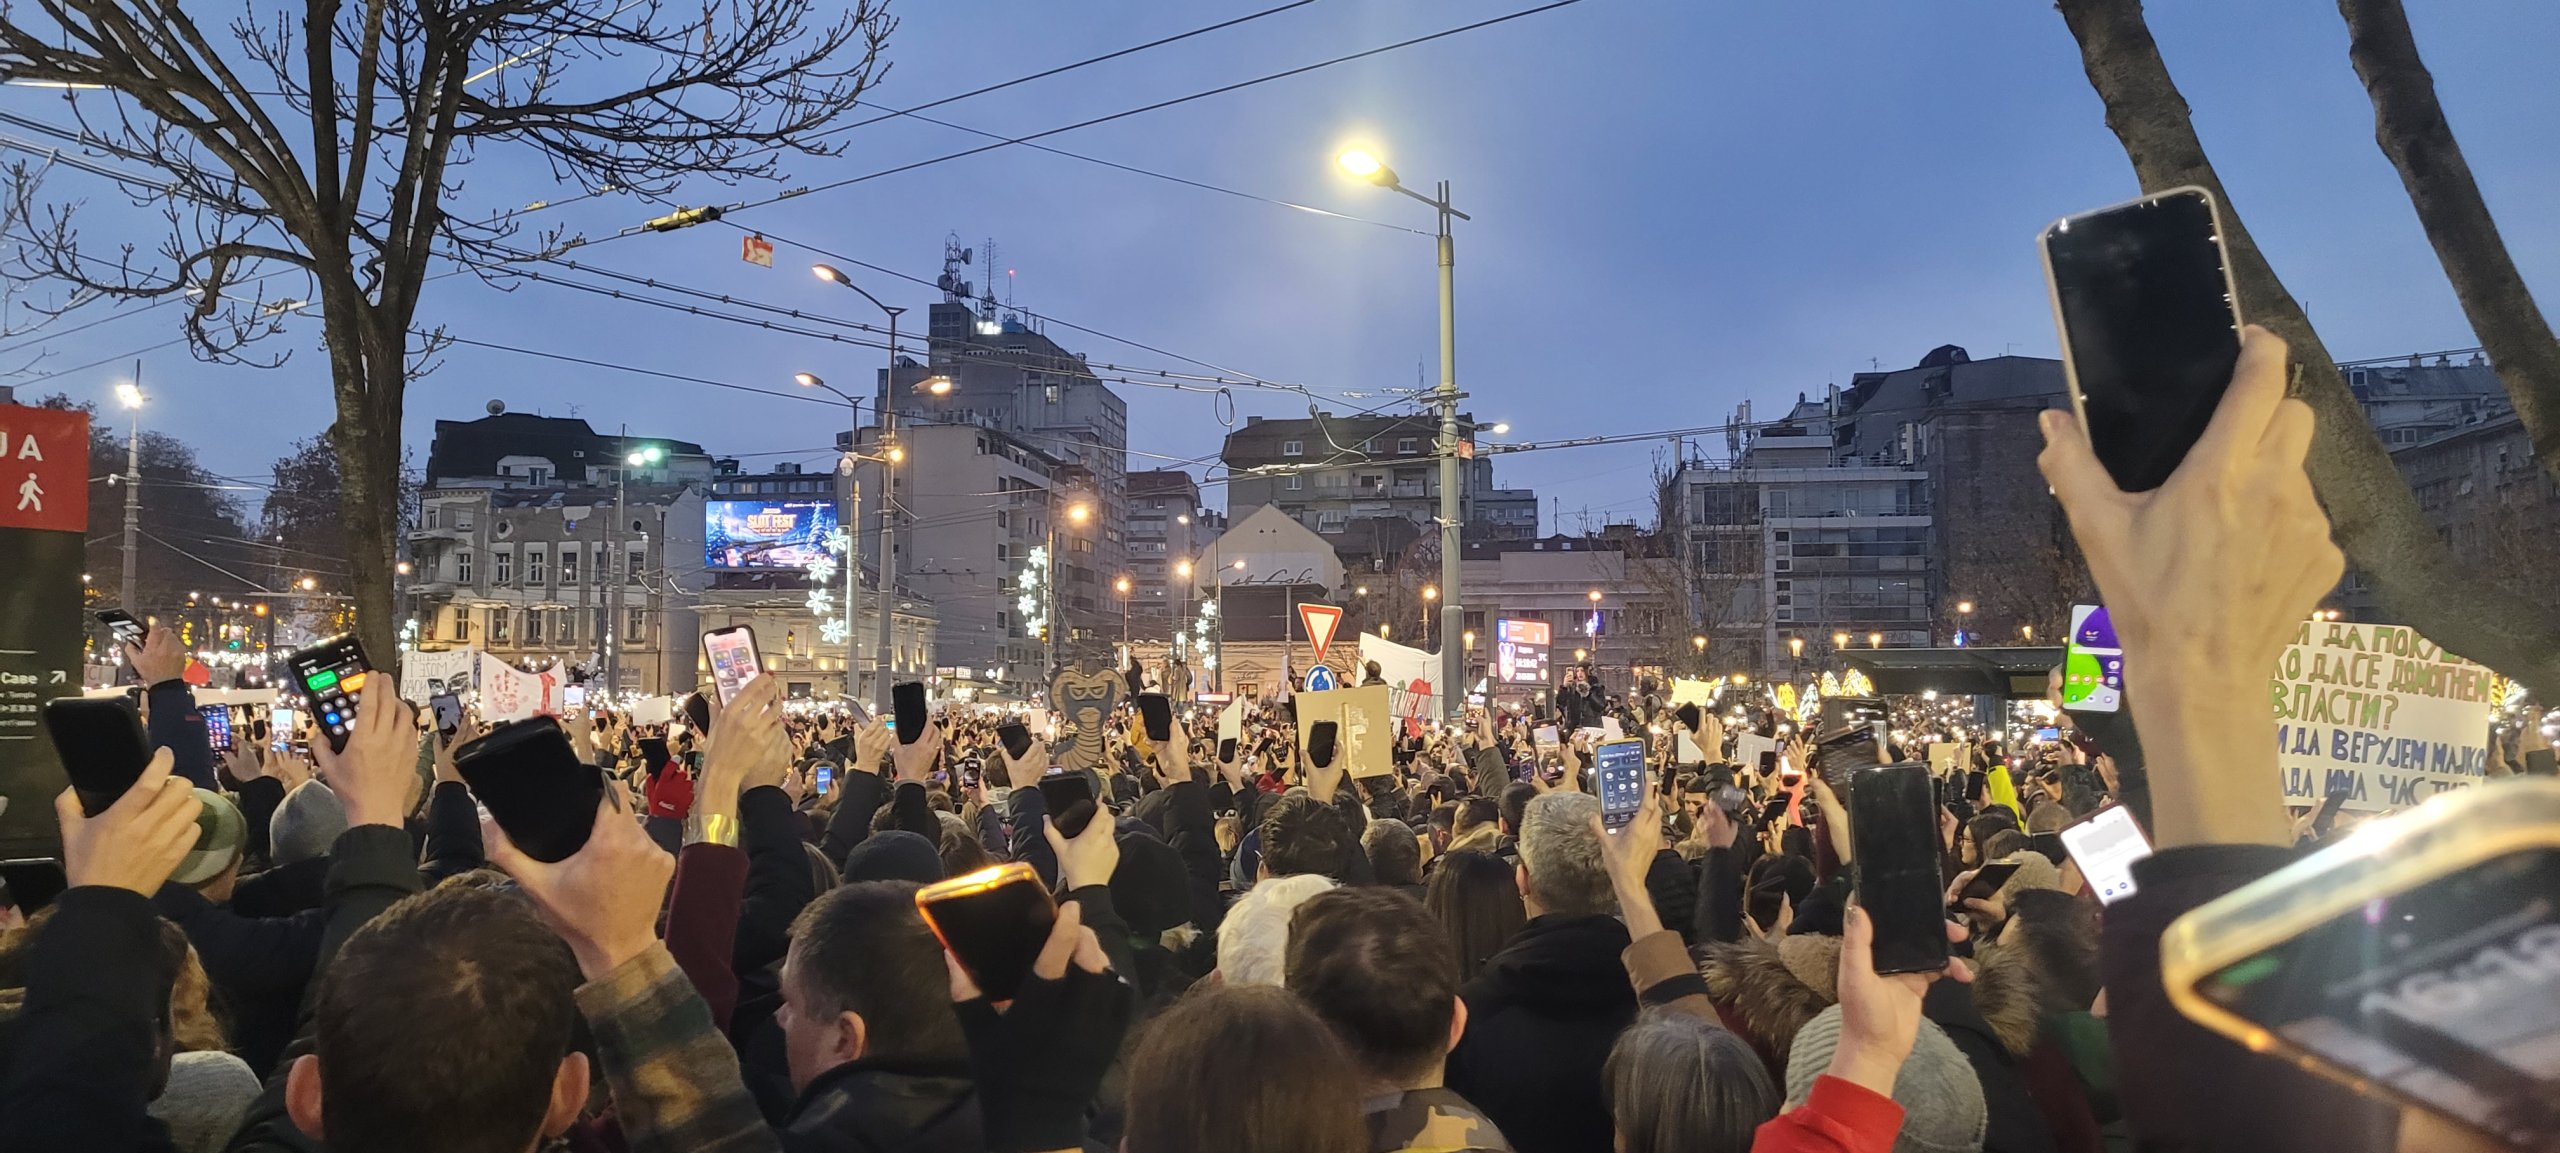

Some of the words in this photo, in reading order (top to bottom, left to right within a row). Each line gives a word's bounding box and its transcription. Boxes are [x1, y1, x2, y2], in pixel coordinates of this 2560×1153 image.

[747, 514, 770, 529] SLOT
[772, 514, 797, 529] FEST
[2322, 624, 2366, 651] ДА
[2269, 679, 2399, 730] ВЛАСТИ?
[2291, 726, 2320, 756] ДА
[2331, 728, 2427, 771] ВЕРУЈЕМ
